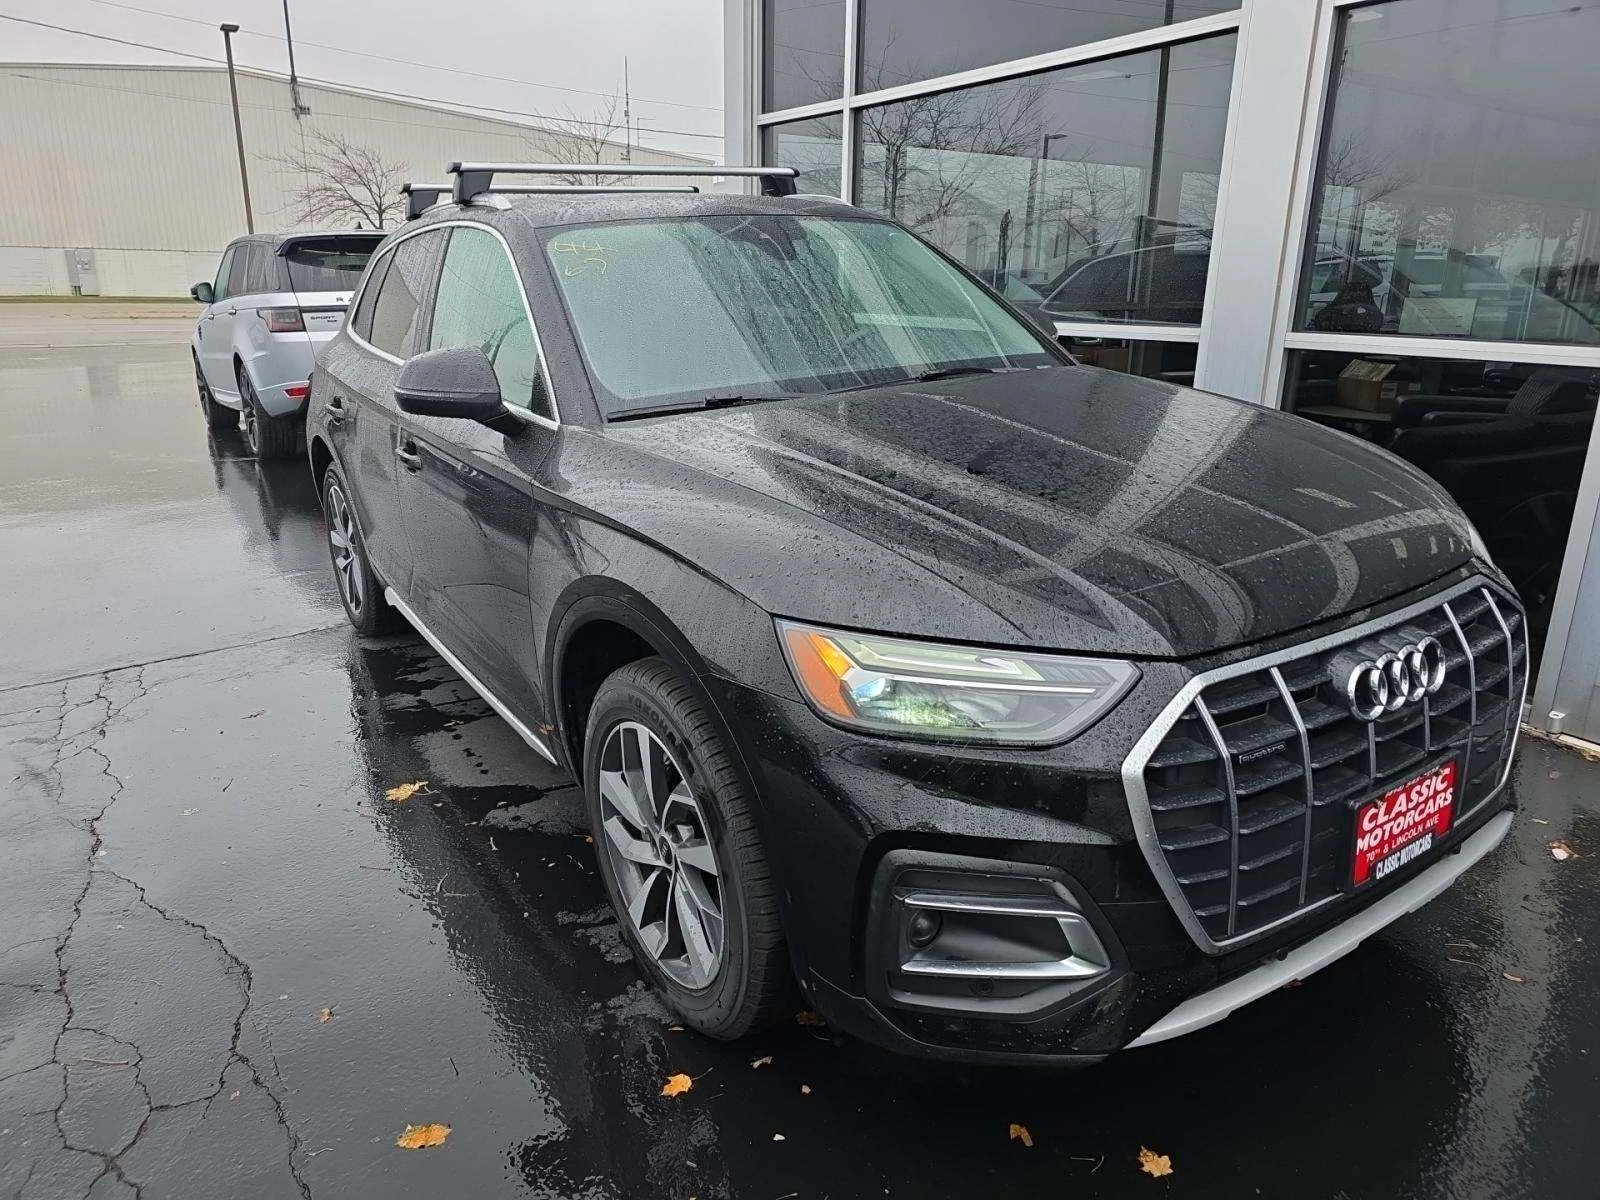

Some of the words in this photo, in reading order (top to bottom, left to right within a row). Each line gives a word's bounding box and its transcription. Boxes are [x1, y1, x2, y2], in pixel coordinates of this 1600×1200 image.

[1356, 788, 1453, 855] MOTORCARS
[1362, 767, 1450, 831] CLASSIC
[1376, 852, 1400, 879] CLASSIC
[1400, 832, 1432, 866] MOTORCARS
[1383, 844, 1389, 854] &
[1392, 823, 1423, 848] LINCOLN
[1425, 814, 1439, 829] AVE
